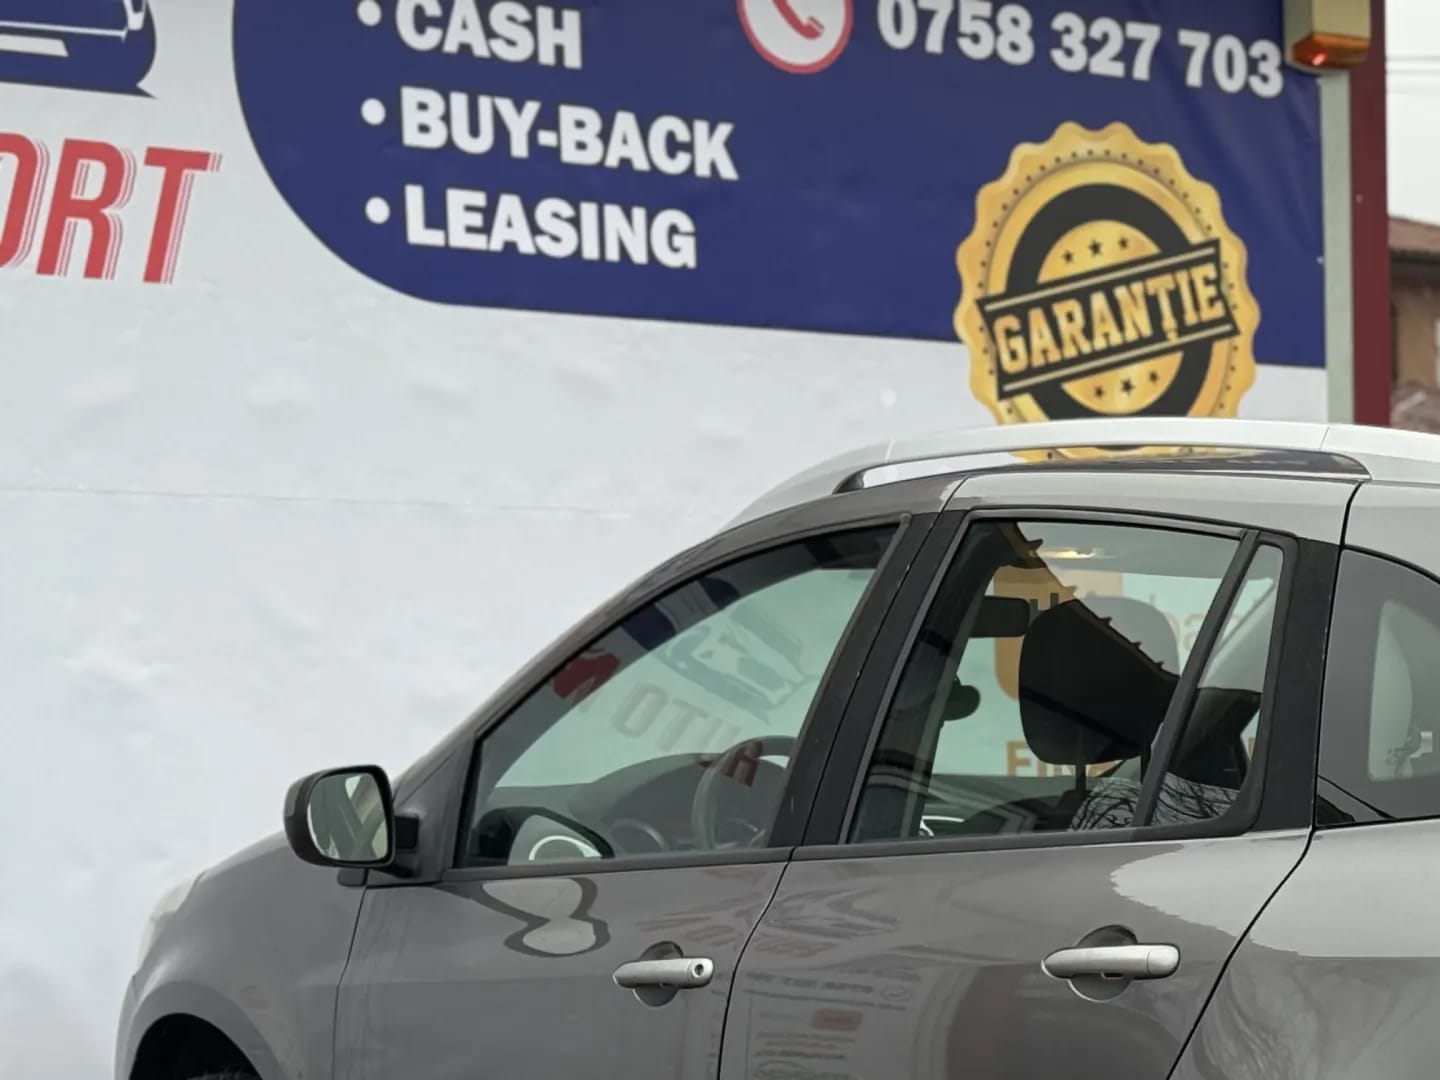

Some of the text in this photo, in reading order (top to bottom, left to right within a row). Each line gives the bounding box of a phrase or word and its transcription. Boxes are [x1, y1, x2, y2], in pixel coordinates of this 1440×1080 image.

[396, 0, 582, 69] CASH
[877, 0, 1284, 98] 0758 327 703
[401, 85, 739, 180] BUY-BACK
[405, 184, 697, 269] LEASING
